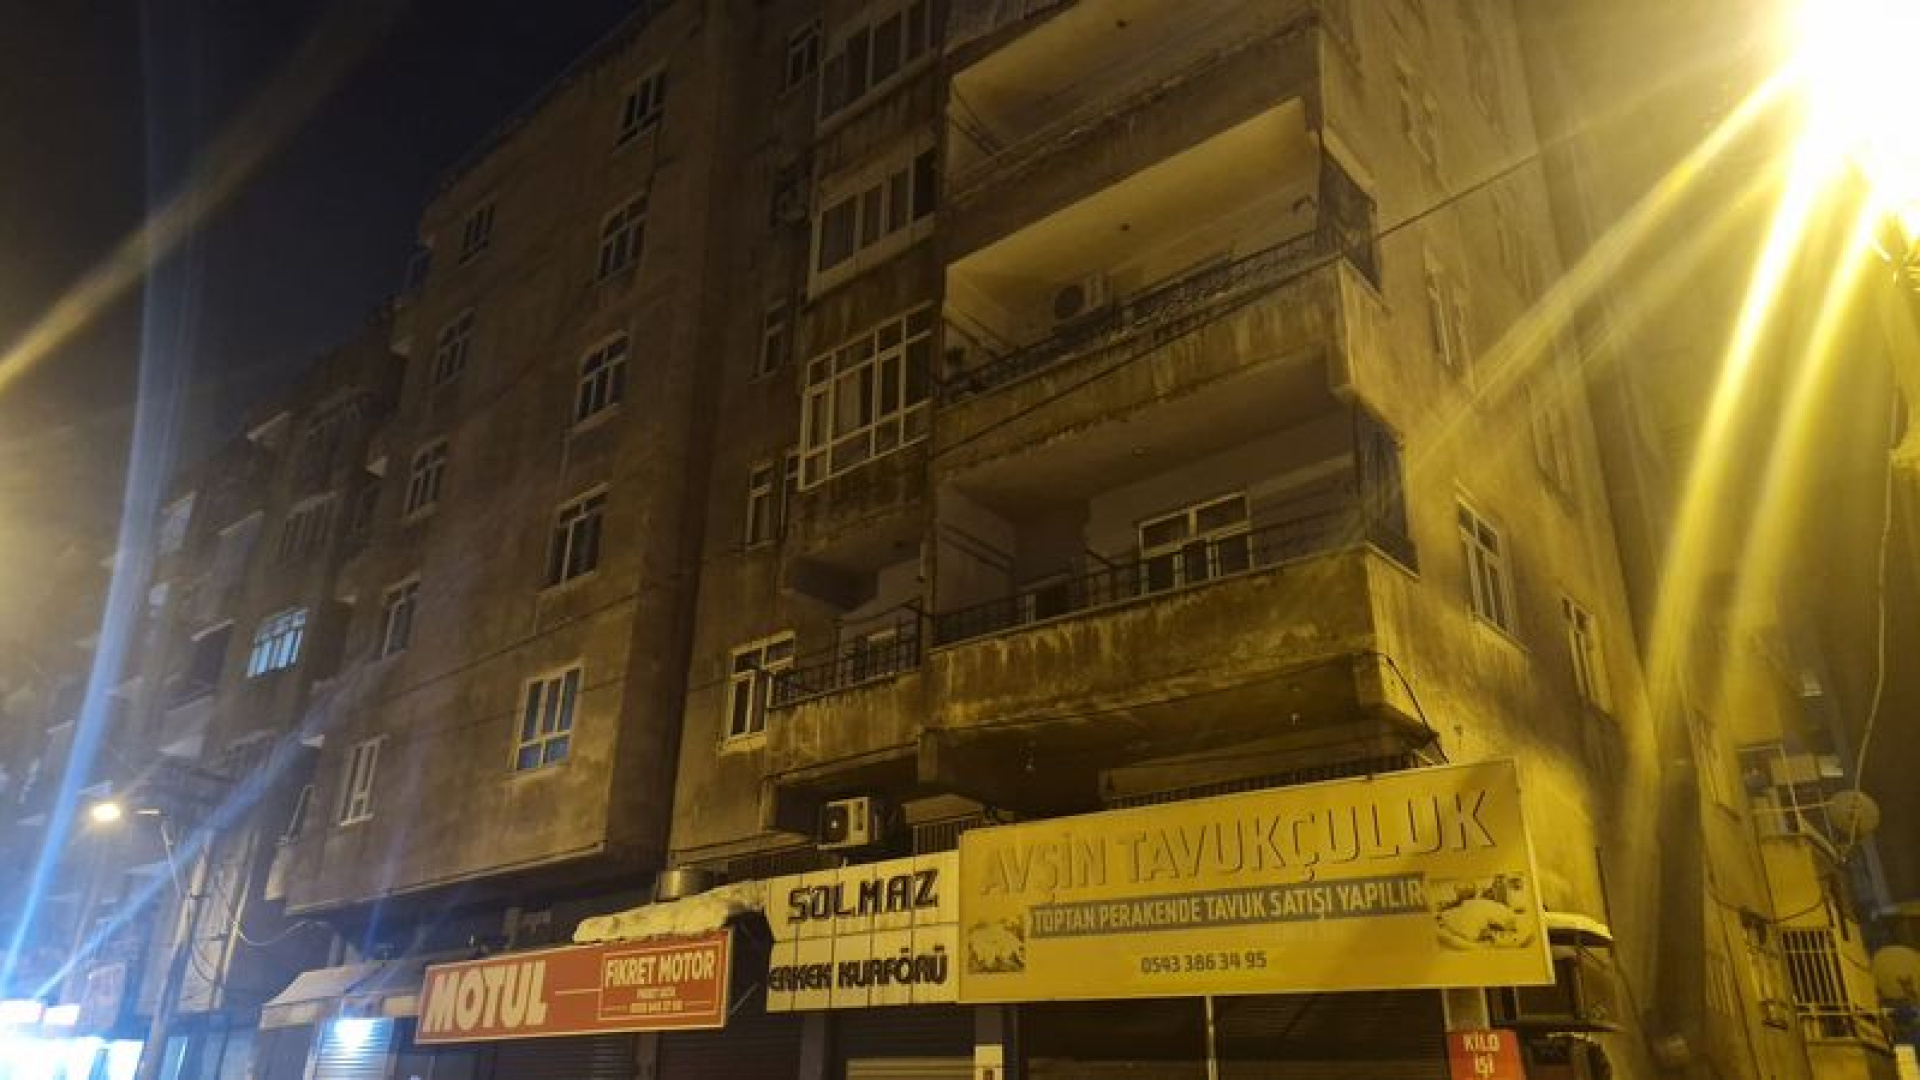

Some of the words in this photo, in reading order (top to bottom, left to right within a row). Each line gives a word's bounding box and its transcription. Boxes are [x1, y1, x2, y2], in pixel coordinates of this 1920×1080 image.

[980, 831, 1106, 904] AVŞİN
[1117, 789, 1498, 882] TAVUKÇULUK
[787, 868, 938, 924] SOLMAZ
[1034, 905, 1095, 934] TOPTAN
[1100, 899, 1201, 929] PERAKENDE
[1204, 892, 1267, 923] TAVUK
[1270, 885, 1332, 921] SATIŞI
[1335, 878, 1423, 911] YAPILIR
[658, 950, 715, 984] MOTOR
[769, 963, 833, 991] ERKEK
[1141, 956, 1180, 974] 0543
[1184, 954, 1215, 973] 386
[1217, 952, 1241, 970] 34
[1244, 950, 1267, 969] 95
[423, 959, 548, 1033] MOTUL
